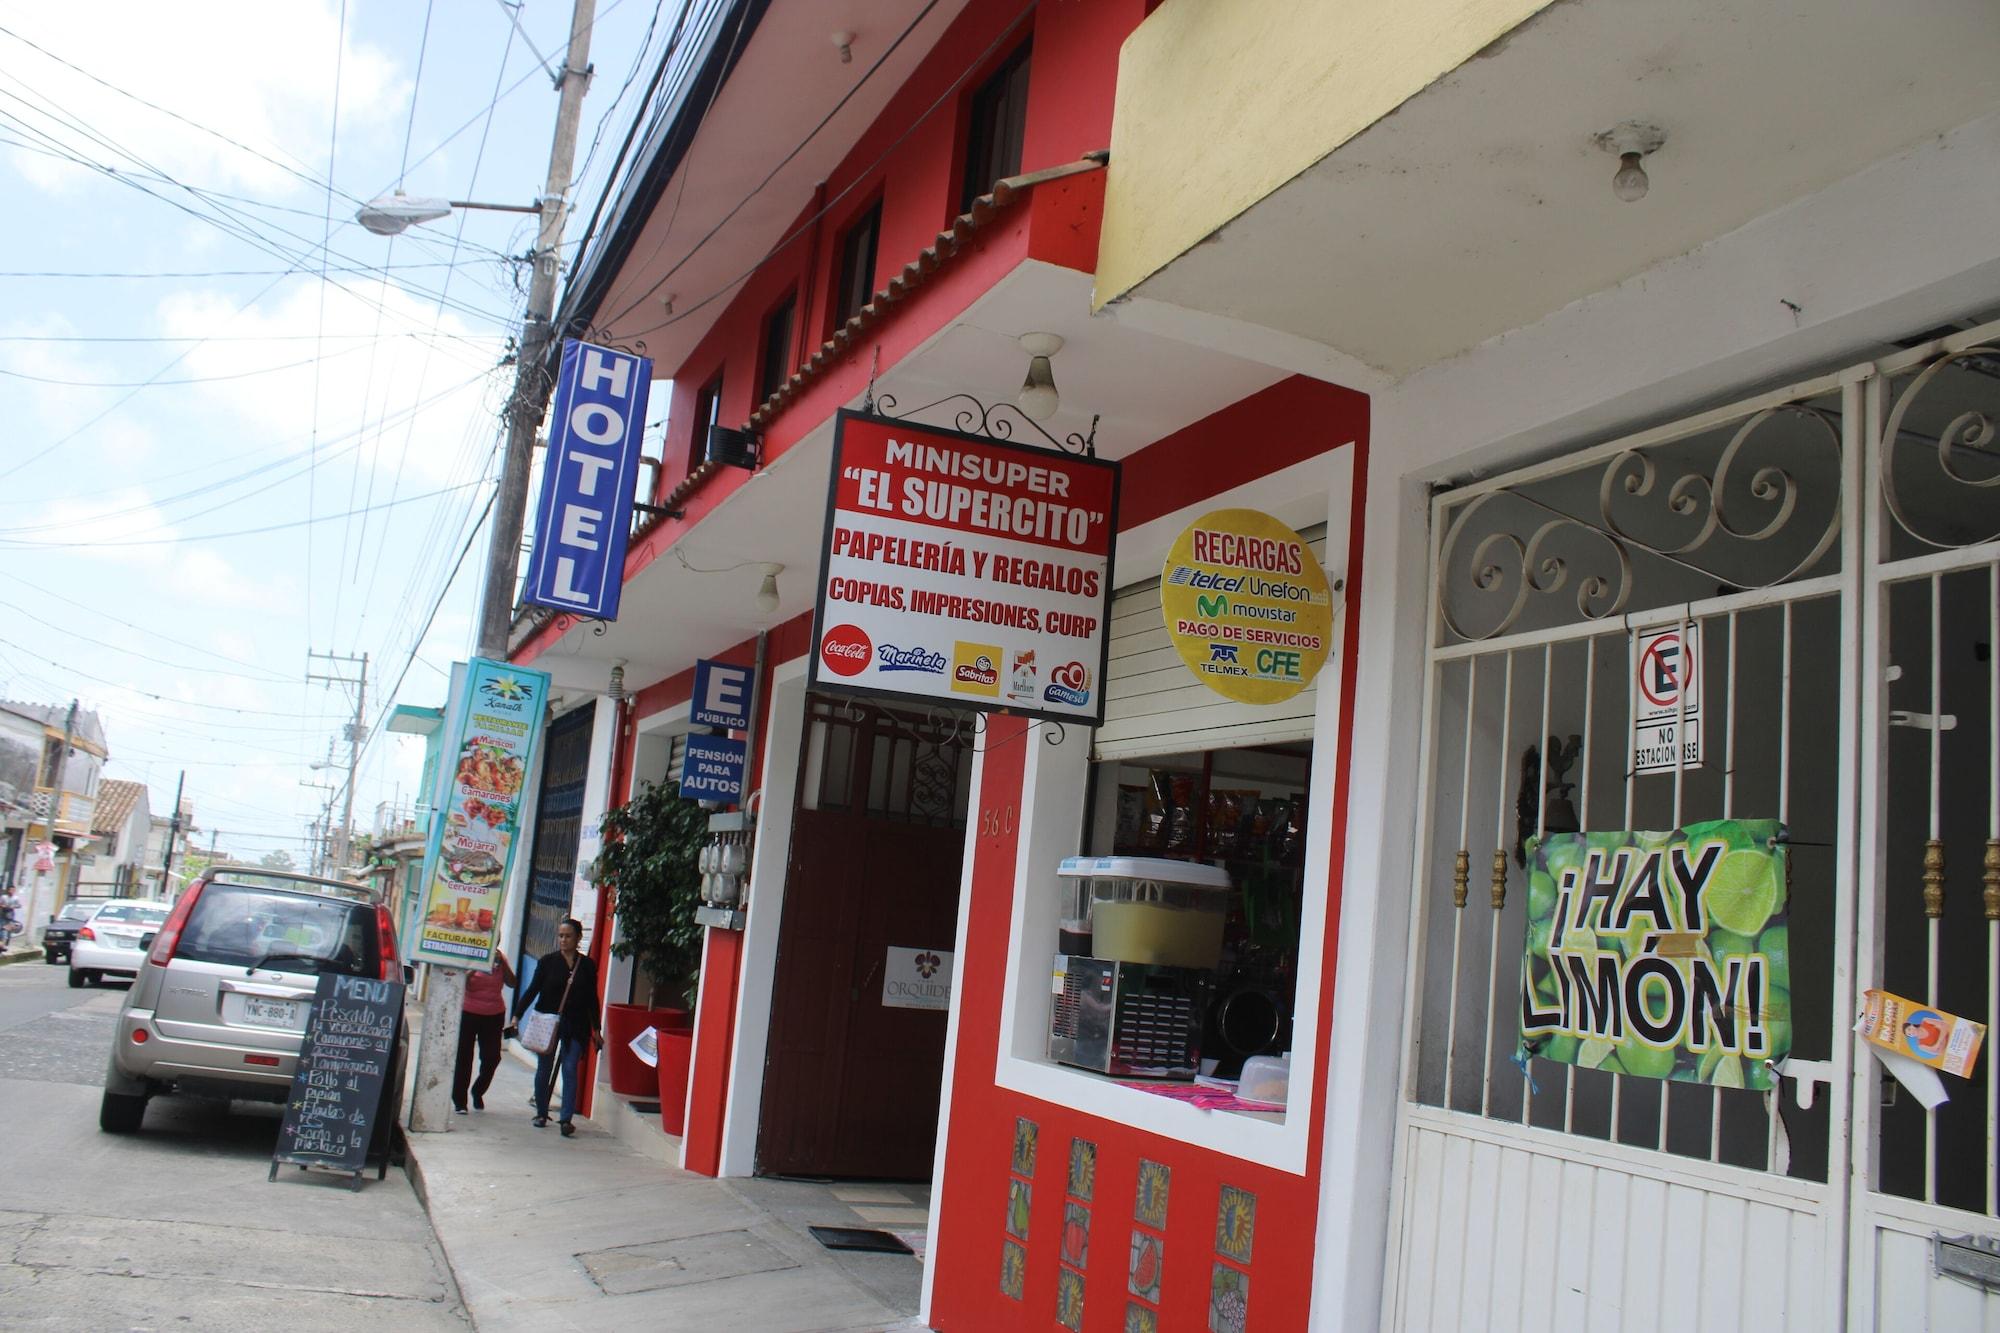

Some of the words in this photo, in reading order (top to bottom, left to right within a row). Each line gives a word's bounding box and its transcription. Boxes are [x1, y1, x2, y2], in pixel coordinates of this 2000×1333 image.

[552, 350, 631, 604] HOTEL
[885, 439, 1070, 498] MINISUPER
[832, 527, 966, 577] PAPELERÍA
[972, 551, 988, 579] Y
[992, 554, 1099, 598] REGALOS
[1194, 530, 1302, 576] RECARGAS
[1189, 570, 1245, 593] telcel
[1250, 576, 1310, 602] Unefon
[829, 577, 907, 613] COPIAS,
[911, 590, 1042, 634] IMPRESIONES,
[1045, 612, 1097, 640] CURP
[1233, 604, 1296, 623] movistar
[1178, 621, 1219, 637] PAGO
[1223, 627, 1242, 640] DE
[1246, 629, 1320, 649] SERVICIOS
[879, 644, 946, 670] Marinela
[1200, 663, 1248, 677] TELMEX
[1257, 649, 1301, 677] CFE
[958, 667, 995, 684] Sabritas
[705, 666, 746, 715] E
[1048, 685, 1085, 704] Gamesa
[696, 711, 746, 728] PÚBLICO
[1658, 728, 1674, 744] NO
[688, 747, 743, 764] PENSIÓN
[698, 762, 731, 776] PARA
[462, 785, 512, 803] Camarones
[684, 775, 740, 794] AUTOS
[457, 836, 497, 851] Mojarra
[447, 880, 489, 895] Cervezas
[1553, 843, 1724, 948] ¡HAY
[426, 930, 487, 947] FACTURAMOS
[333, 974, 389, 1003] MENU
[1522, 937, 1766, 1053] LIMÓN!
[320, 999, 375, 1025] Pescado
[309, 1070, 338, 1087] Pollo
[346, 1075, 358, 1089] al
